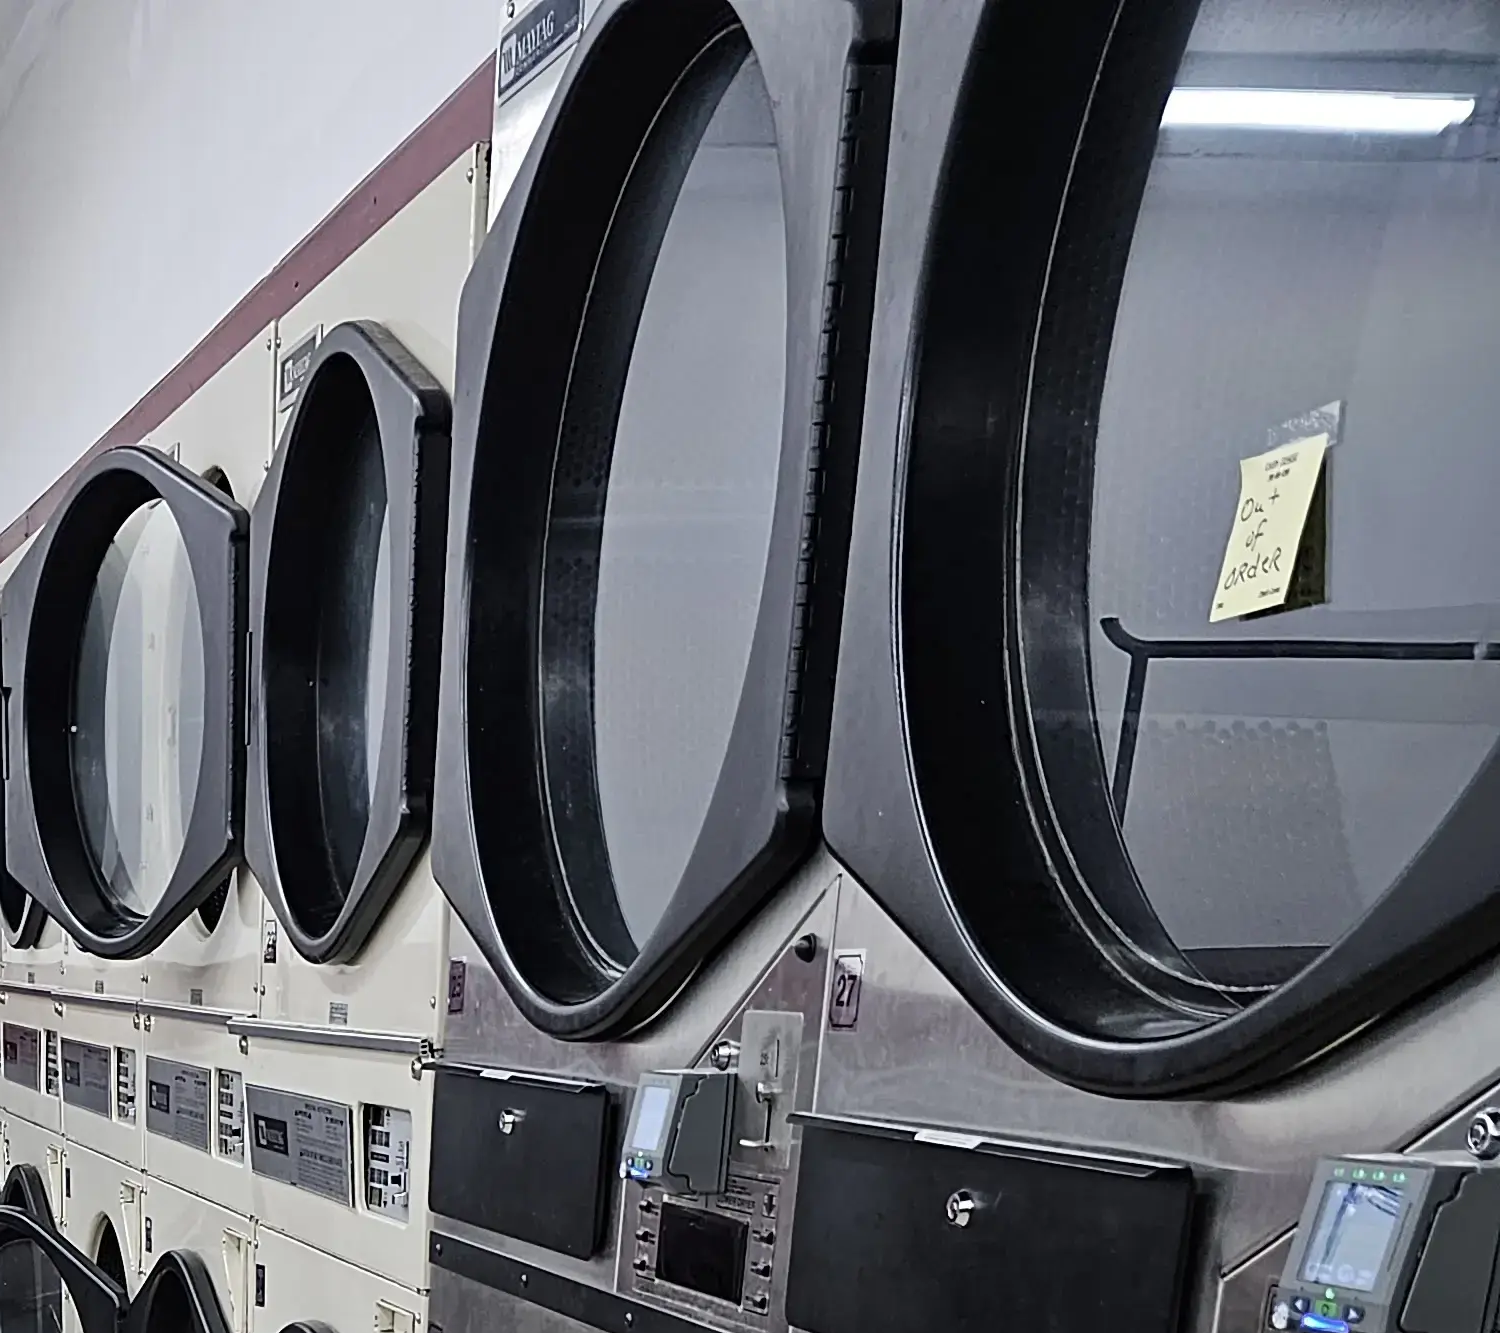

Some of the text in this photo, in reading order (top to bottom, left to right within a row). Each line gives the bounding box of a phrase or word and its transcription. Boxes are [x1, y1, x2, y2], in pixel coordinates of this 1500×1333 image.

[516, 10, 555, 60] MAYTAG
[1245, 518, 1268, 551] of
[835, 974, 858, 1008] 27
